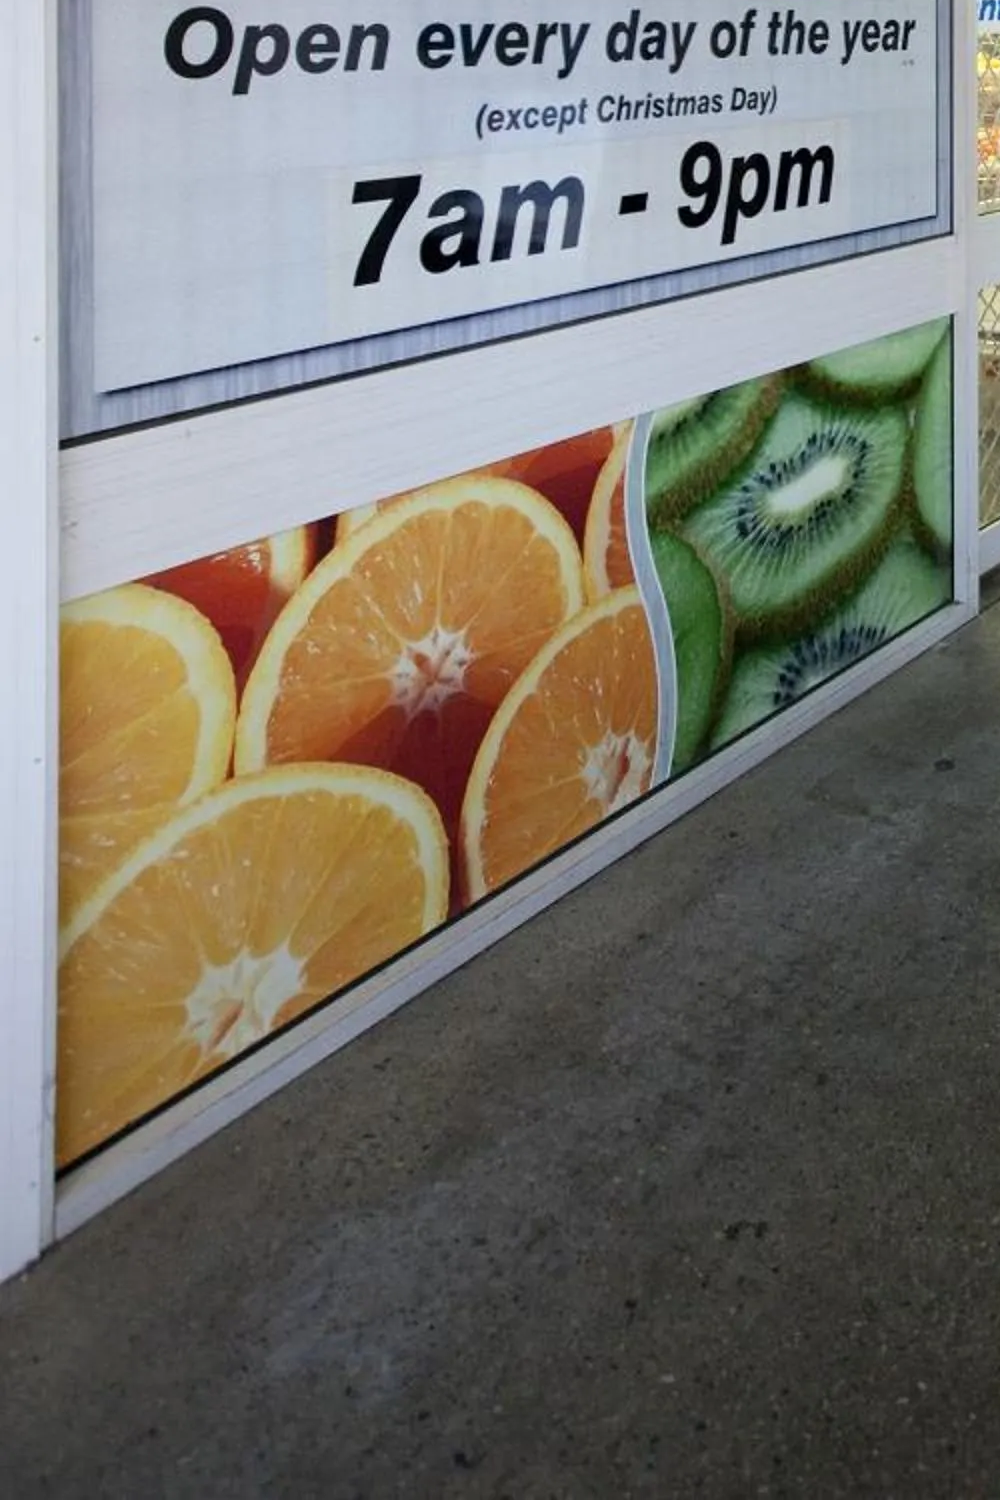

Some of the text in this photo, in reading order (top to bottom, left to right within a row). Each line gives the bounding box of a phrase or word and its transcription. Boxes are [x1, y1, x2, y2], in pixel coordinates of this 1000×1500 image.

[163, 5, 917, 97] Open every day of the year
[475, 85, 778, 139] (except Christmas Day)
[351, 139, 836, 287] 7am - 9pm
